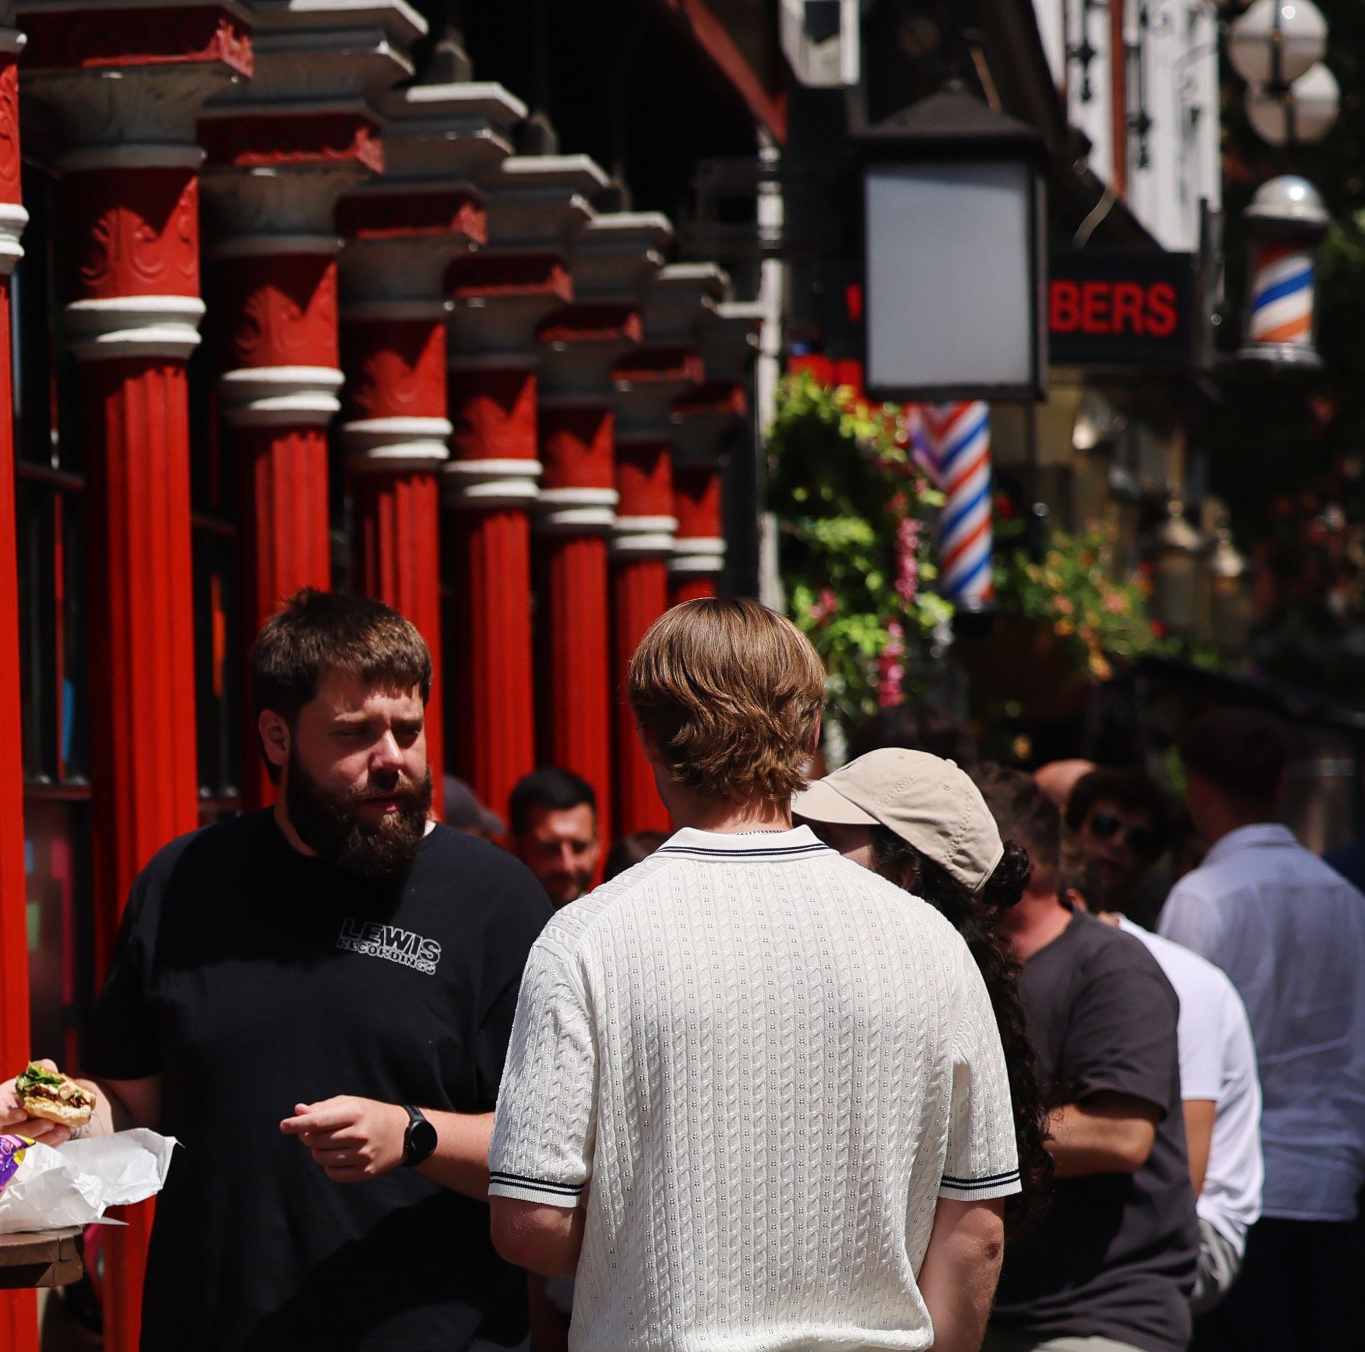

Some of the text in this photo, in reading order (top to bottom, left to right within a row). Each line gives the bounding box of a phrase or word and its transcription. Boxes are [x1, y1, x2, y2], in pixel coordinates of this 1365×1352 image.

[1048, 279, 1178, 337] BERS
[336, 937, 437, 976] RECORDINGS
[340, 918, 442, 965] LEWIS
